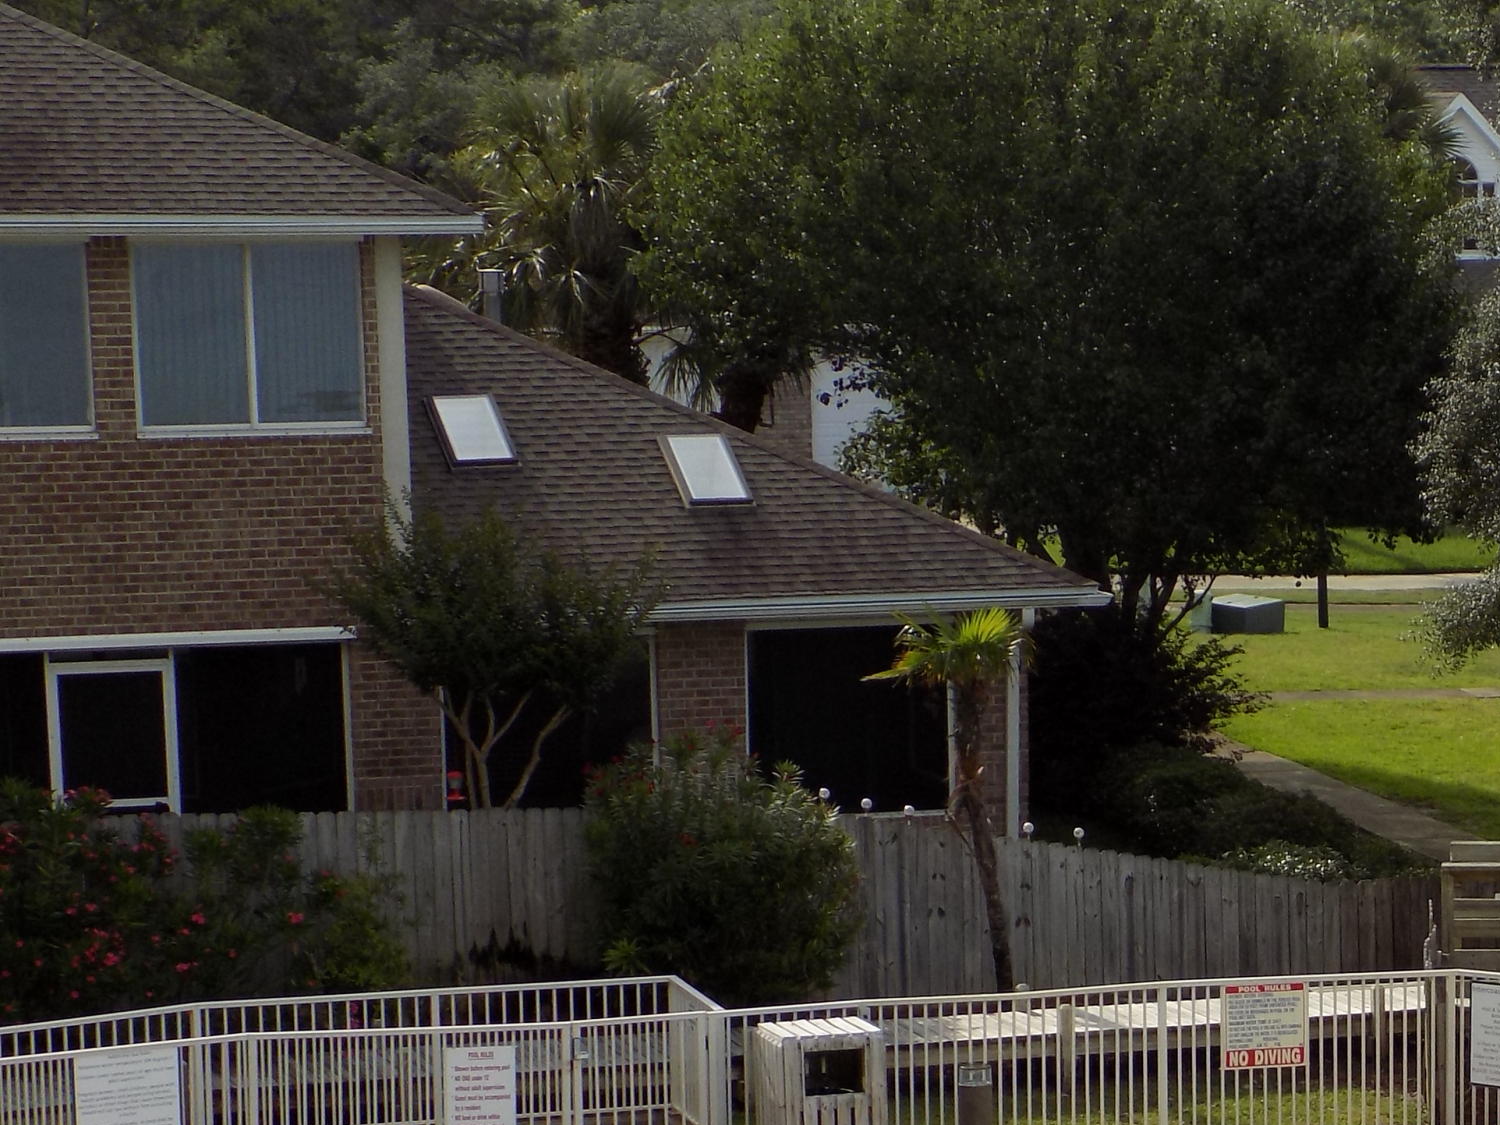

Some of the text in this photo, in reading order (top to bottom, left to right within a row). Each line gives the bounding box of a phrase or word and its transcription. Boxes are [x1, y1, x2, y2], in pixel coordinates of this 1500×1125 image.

[1238, 983, 1292, 993] POOL RULES
[1228, 1047, 1302, 1067] NO DIVING
